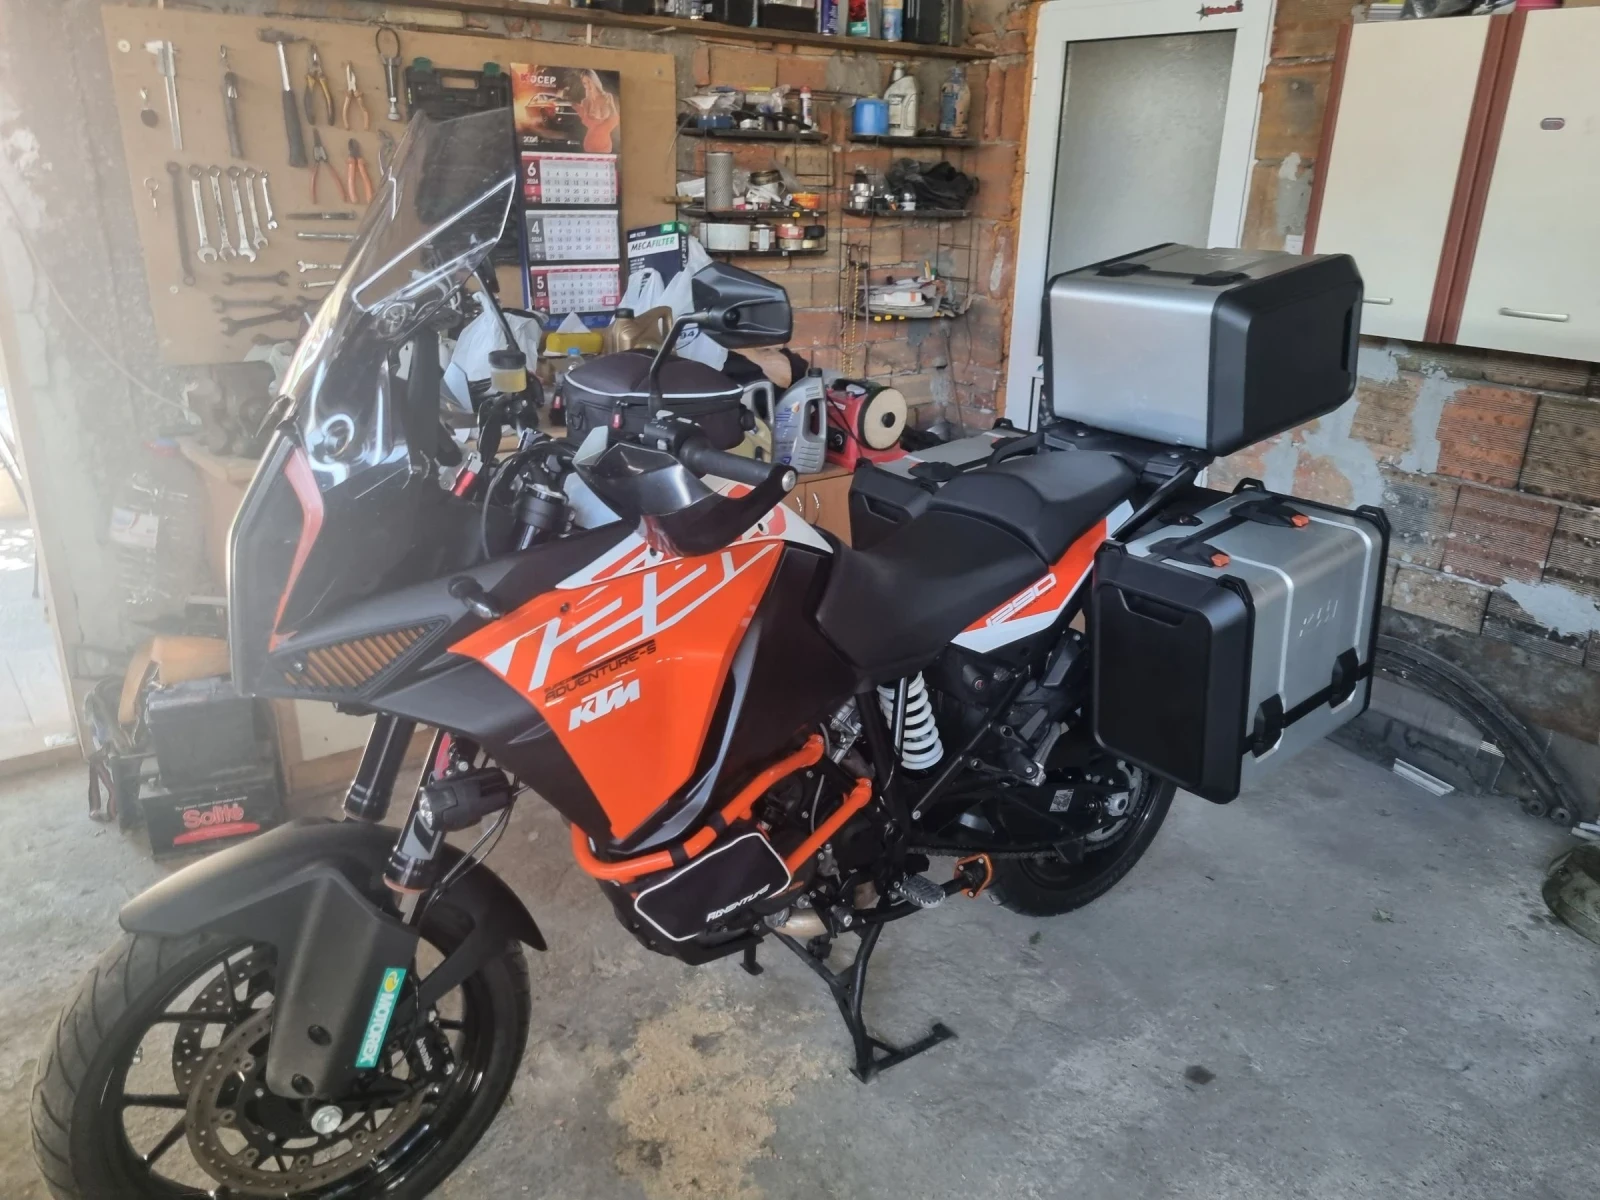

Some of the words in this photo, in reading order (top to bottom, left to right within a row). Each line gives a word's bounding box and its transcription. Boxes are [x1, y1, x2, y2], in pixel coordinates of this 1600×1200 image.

[528, 162, 536, 177] 6
[532, 221, 540, 234] 4
[631, 236, 675, 251] MECAFILTER
[537, 276, 544, 289] 5
[568, 679, 641, 731] KTM
[706, 884, 771, 923] ADVENTURE
[360, 992, 394, 1065] MOTOREX
